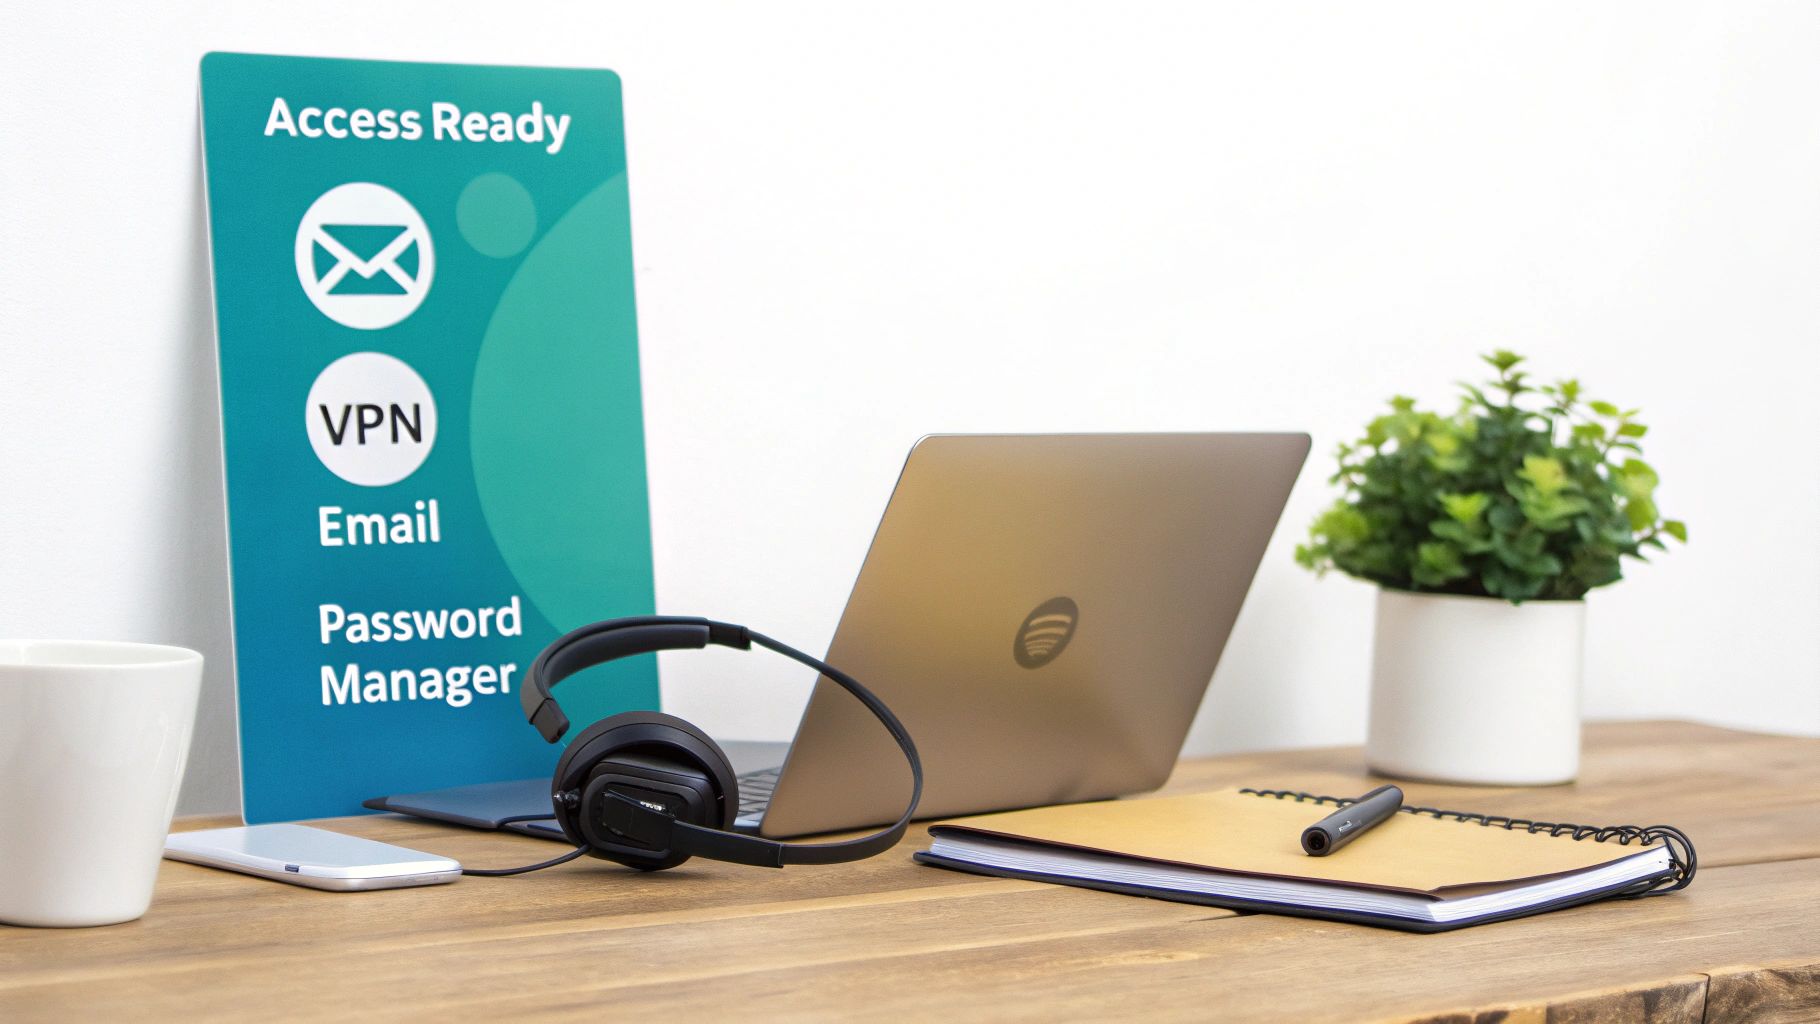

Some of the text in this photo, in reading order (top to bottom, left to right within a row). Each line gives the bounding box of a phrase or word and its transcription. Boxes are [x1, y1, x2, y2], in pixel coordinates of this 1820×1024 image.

[264, 98, 571, 154] Access Ready
[319, 403, 423, 446] VPN
[319, 500, 440, 546] Email
[320, 596, 521, 644] Password
[321, 664, 516, 707] Manager
